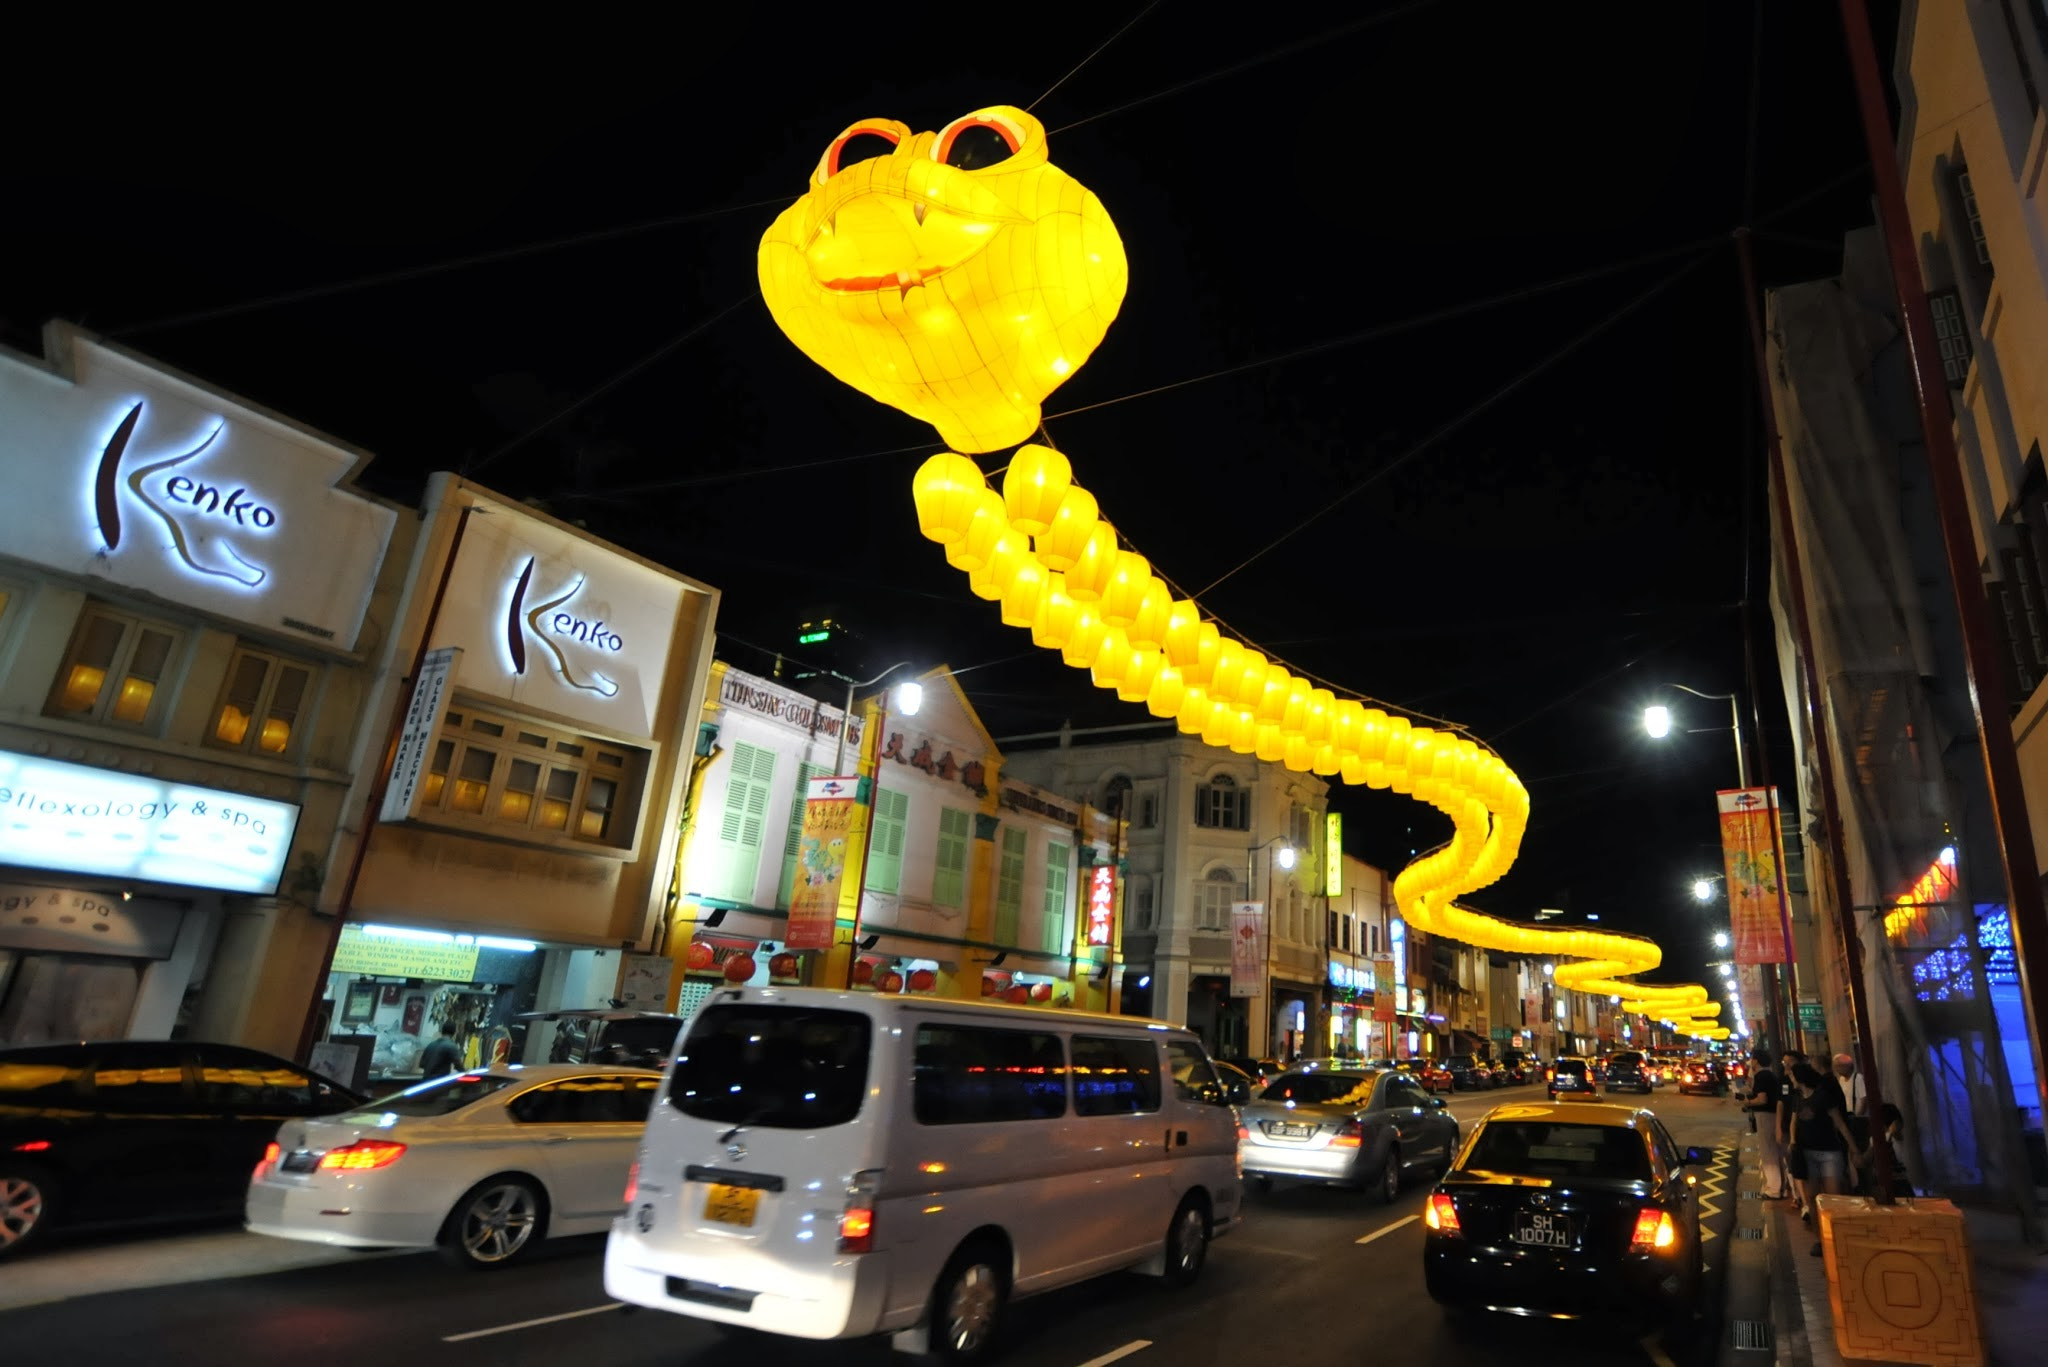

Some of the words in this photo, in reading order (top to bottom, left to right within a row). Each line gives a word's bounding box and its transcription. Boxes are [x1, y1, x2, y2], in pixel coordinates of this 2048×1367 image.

[94, 400, 276, 588] Kenko
[508, 556, 624, 698] Kenko
[425, 676, 443, 723] GLASS
[402, 731, 428, 807] MERCHANT
[191, 800, 209, 817] &
[221, 805, 268, 836] spa
[71, 896, 111, 917] spa
[446, 967, 471, 979] 3027
[1533, 1214, 1553, 1230] SH
